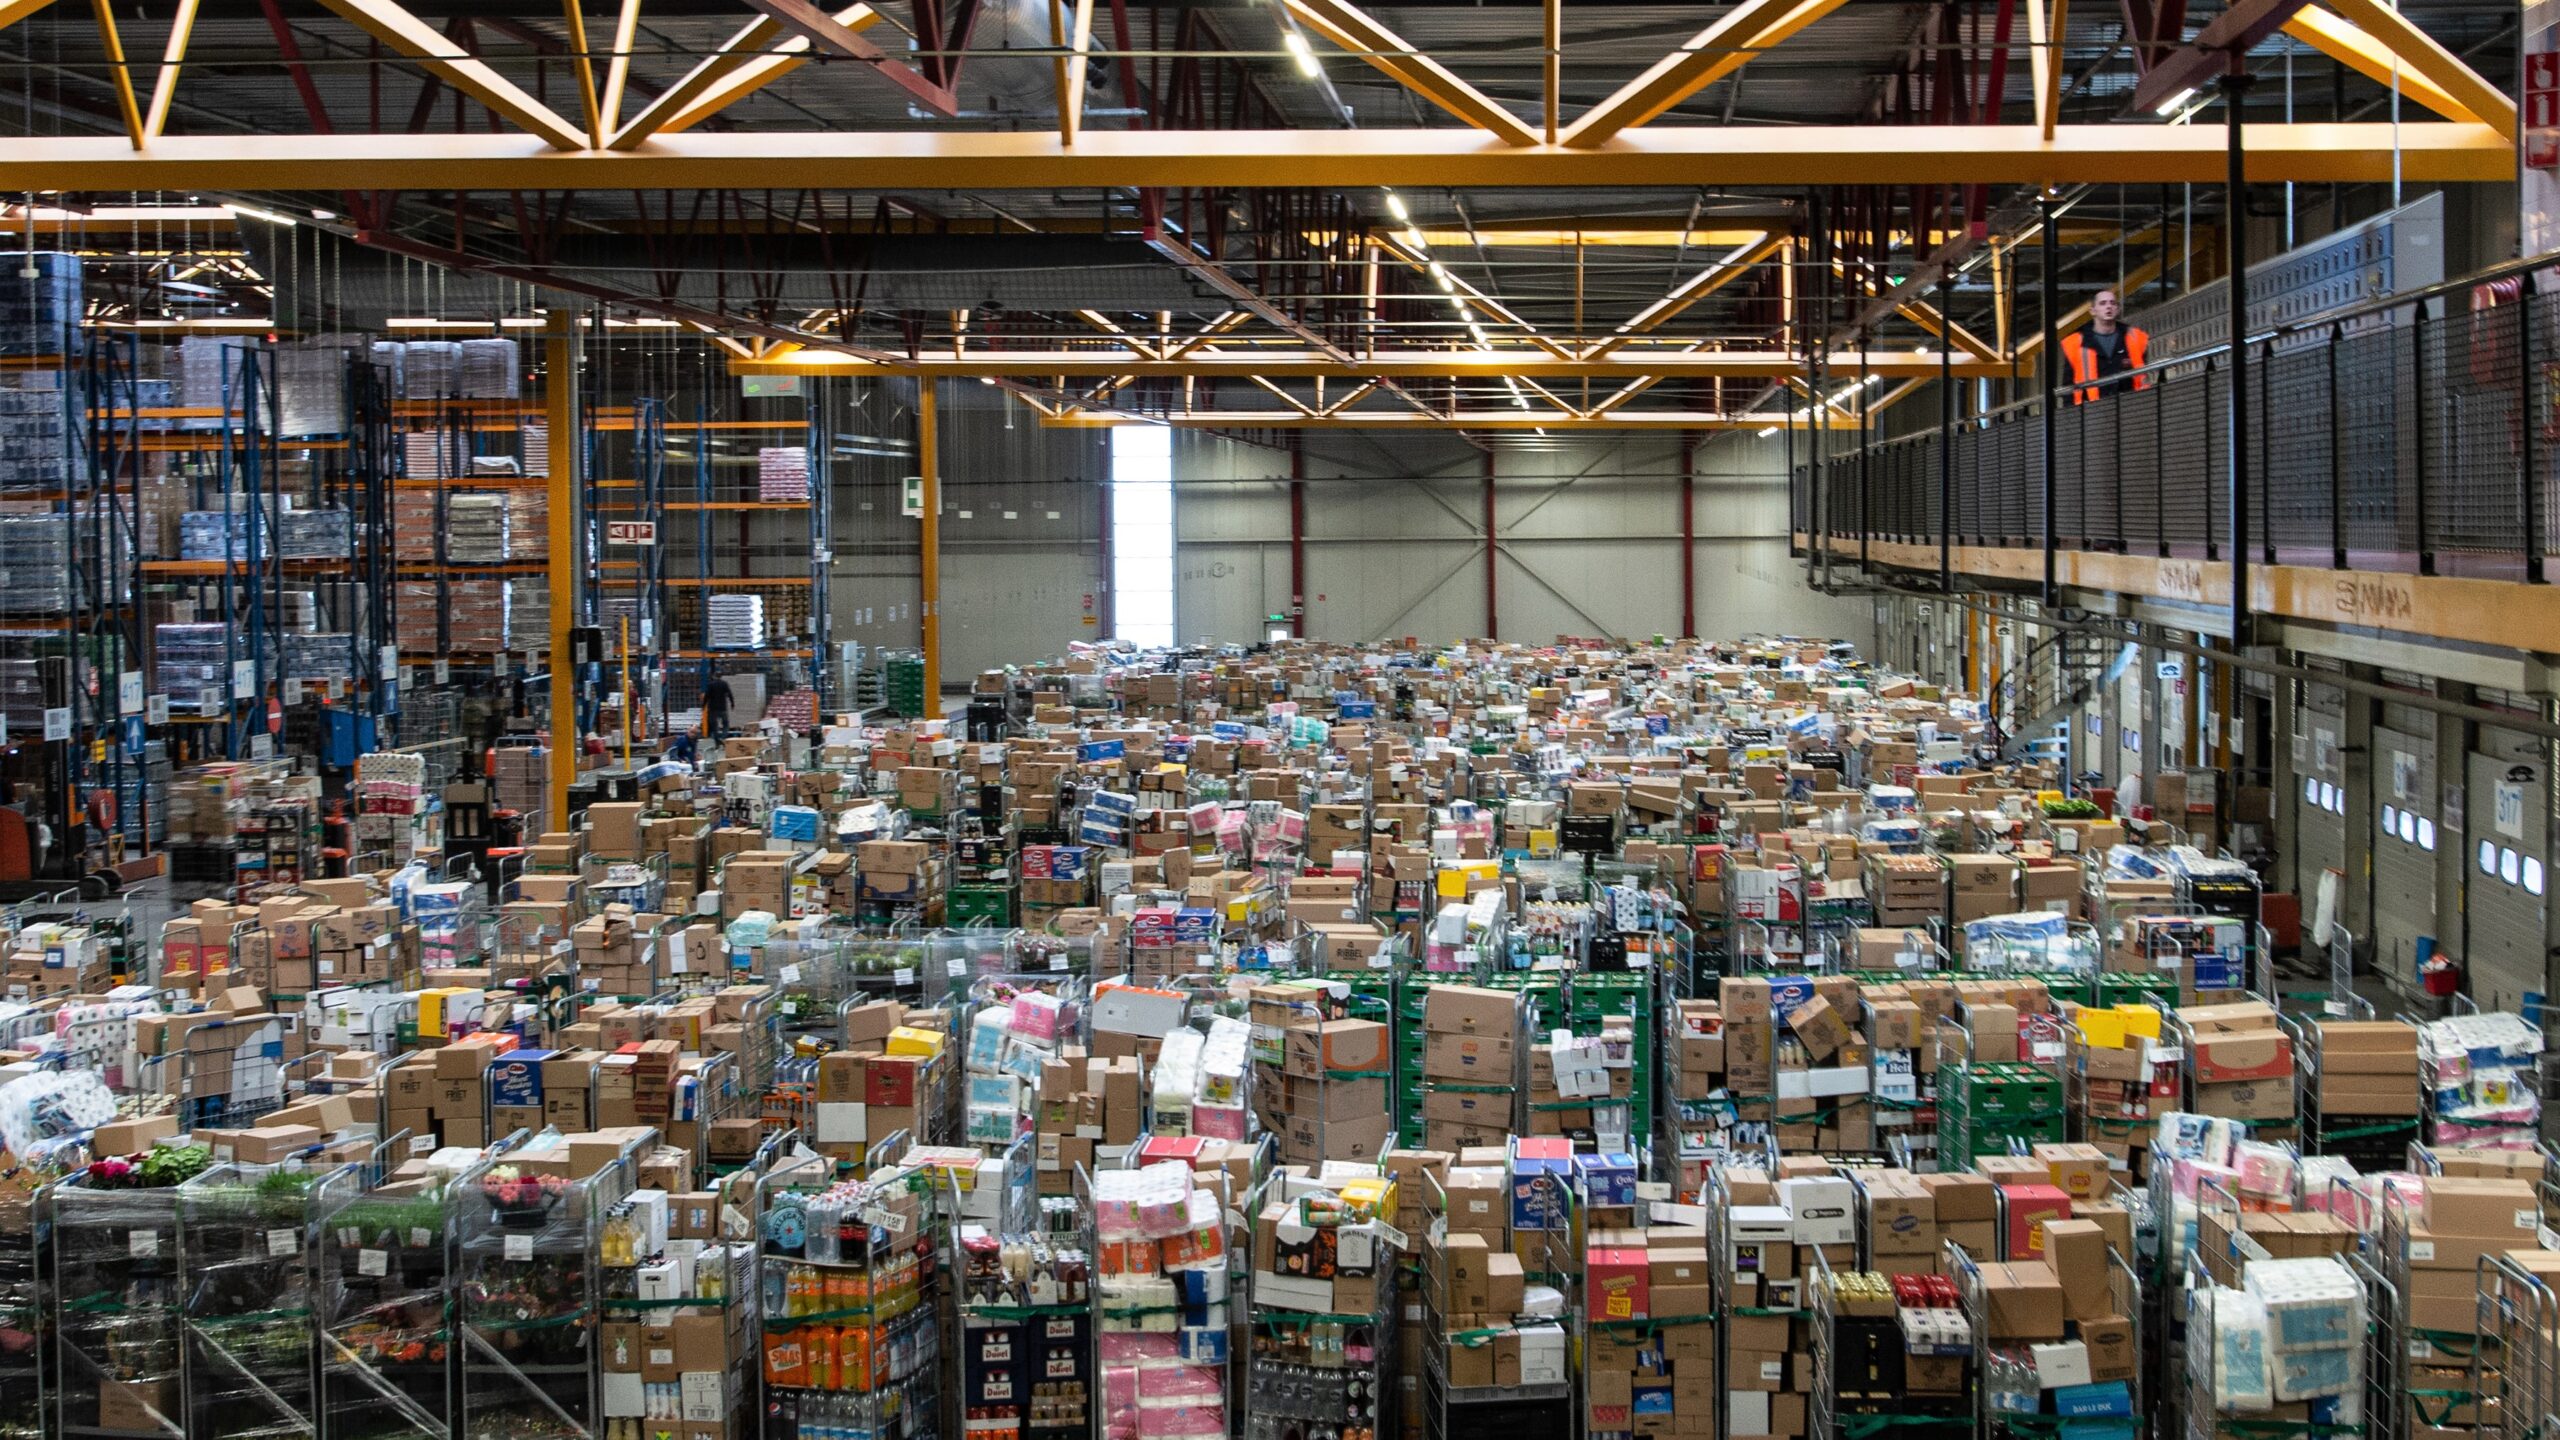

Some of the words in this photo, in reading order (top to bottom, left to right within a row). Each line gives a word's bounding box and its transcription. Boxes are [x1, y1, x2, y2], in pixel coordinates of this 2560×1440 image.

[2498, 788, 2522, 826] 317
[446, 1089, 467, 1099] FRIET
[986, 1349, 1008, 1360] Duvel
[1049, 1364, 1073, 1375] Duvel
[987, 1388, 1008, 1398] Duvel
